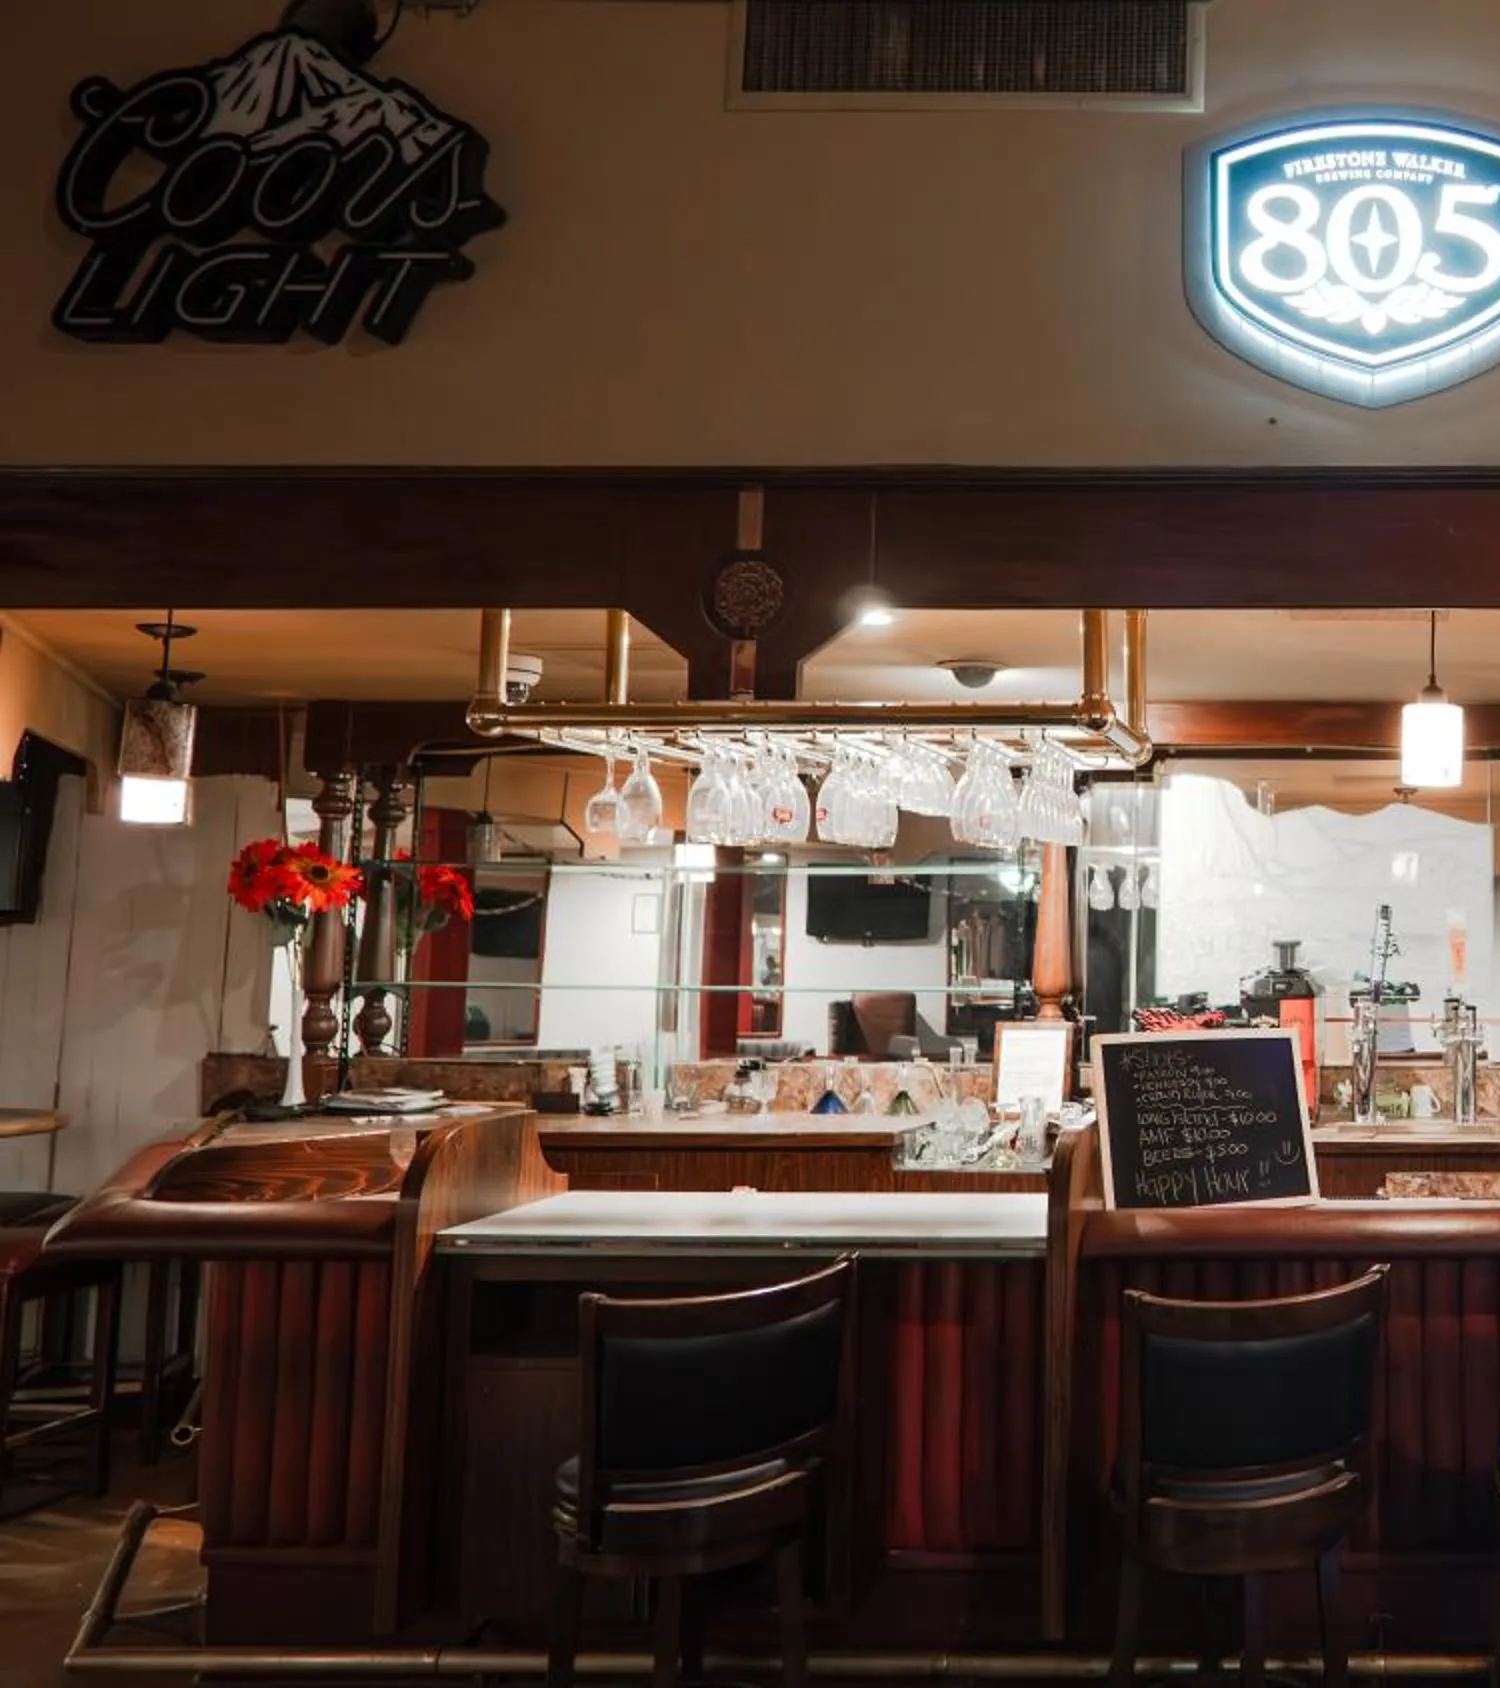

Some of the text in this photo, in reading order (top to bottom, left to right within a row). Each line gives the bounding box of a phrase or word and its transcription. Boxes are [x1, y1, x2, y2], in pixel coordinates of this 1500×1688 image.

[1283, 151, 1466, 179] FIRESTONE WALKER
[1315, 169, 1435, 185] BREWING COMPANY
[57, 247, 462, 333] LIGHT
[1139, 1127, 1173, 1145] AMF
